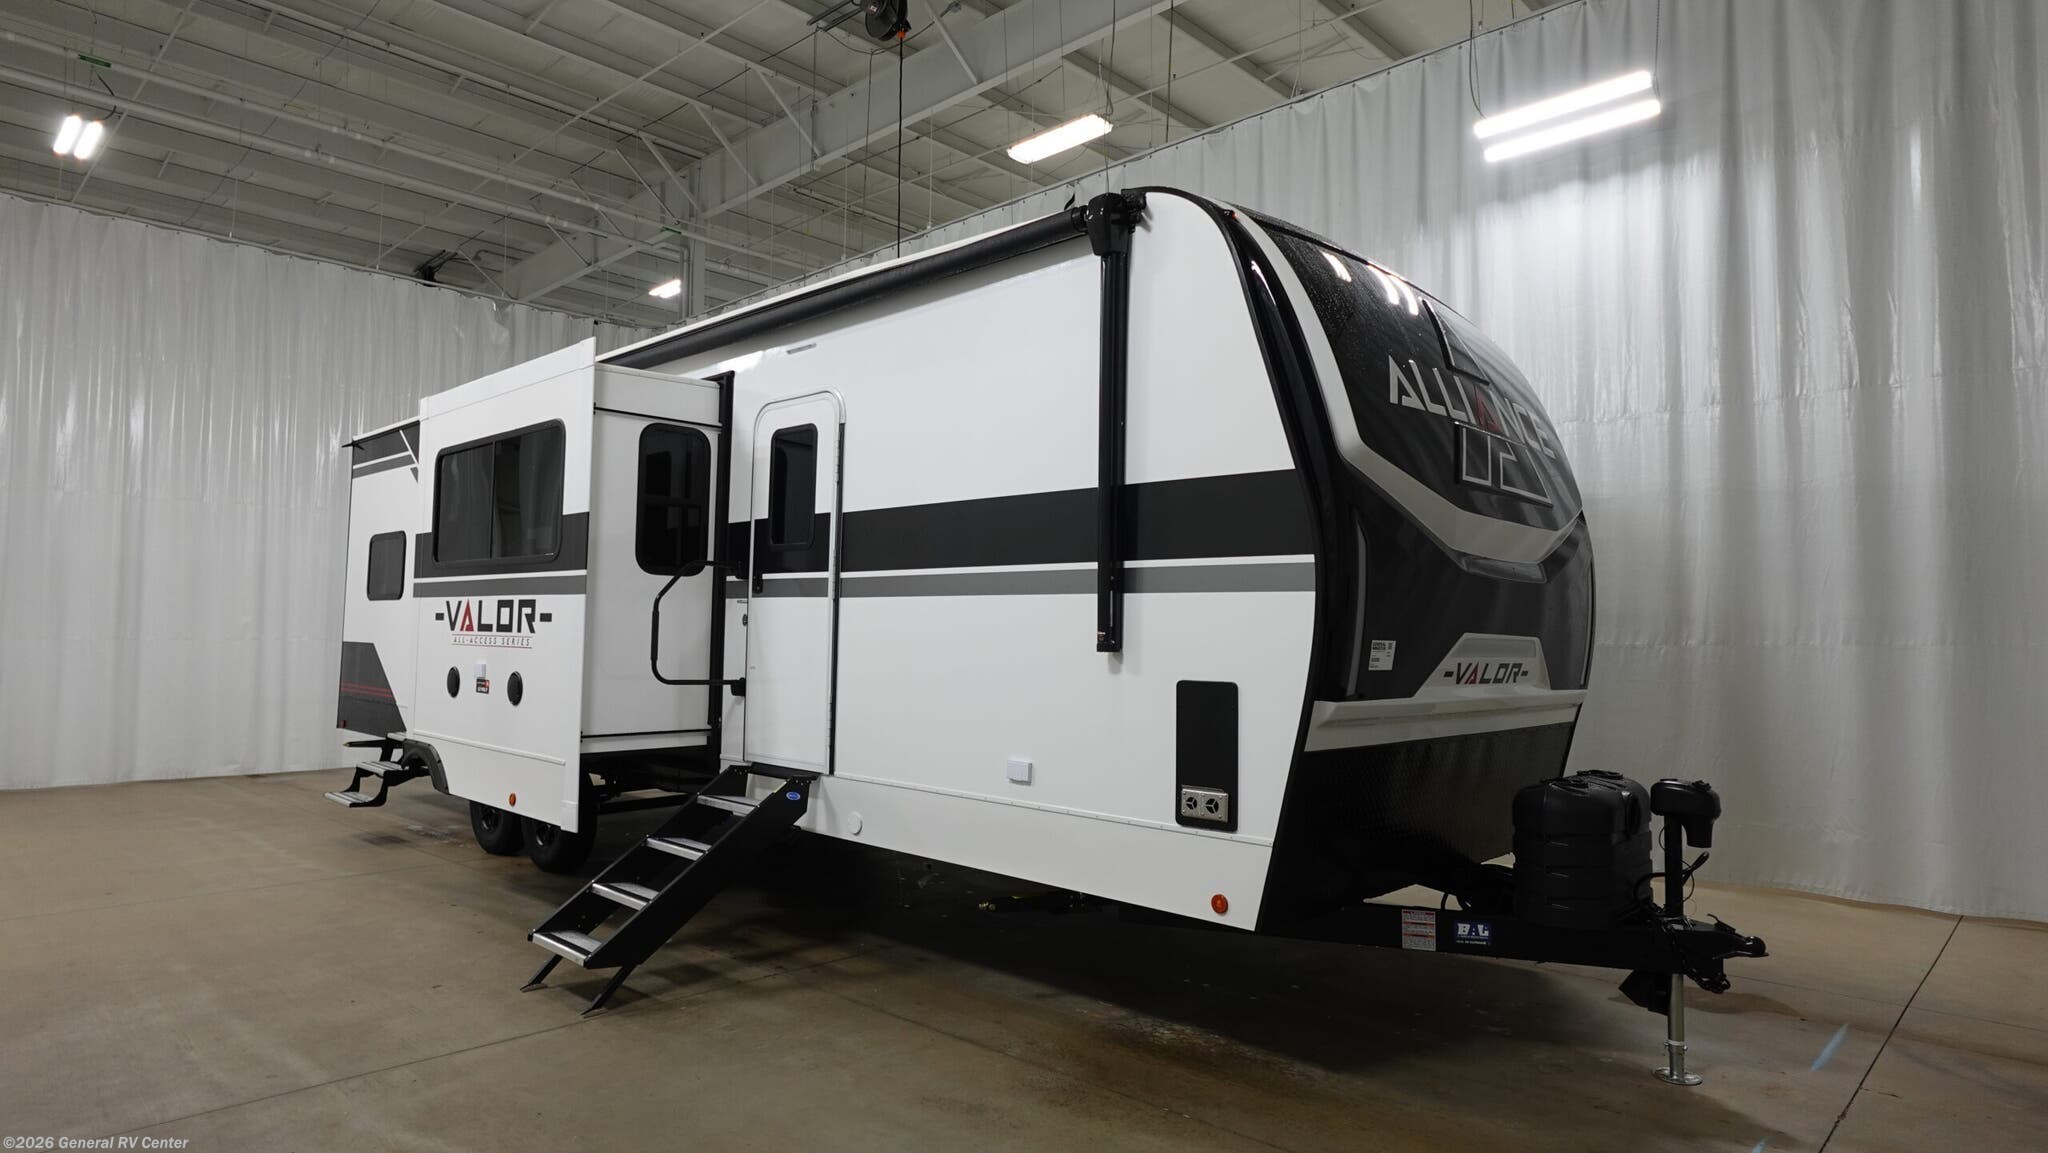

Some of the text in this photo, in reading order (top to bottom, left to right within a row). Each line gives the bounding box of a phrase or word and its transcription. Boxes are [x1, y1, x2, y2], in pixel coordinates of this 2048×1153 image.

[1388, 355, 1556, 460] ALLIANCE
[453, 636, 531, 647] ALL-ACCESS SERIES
